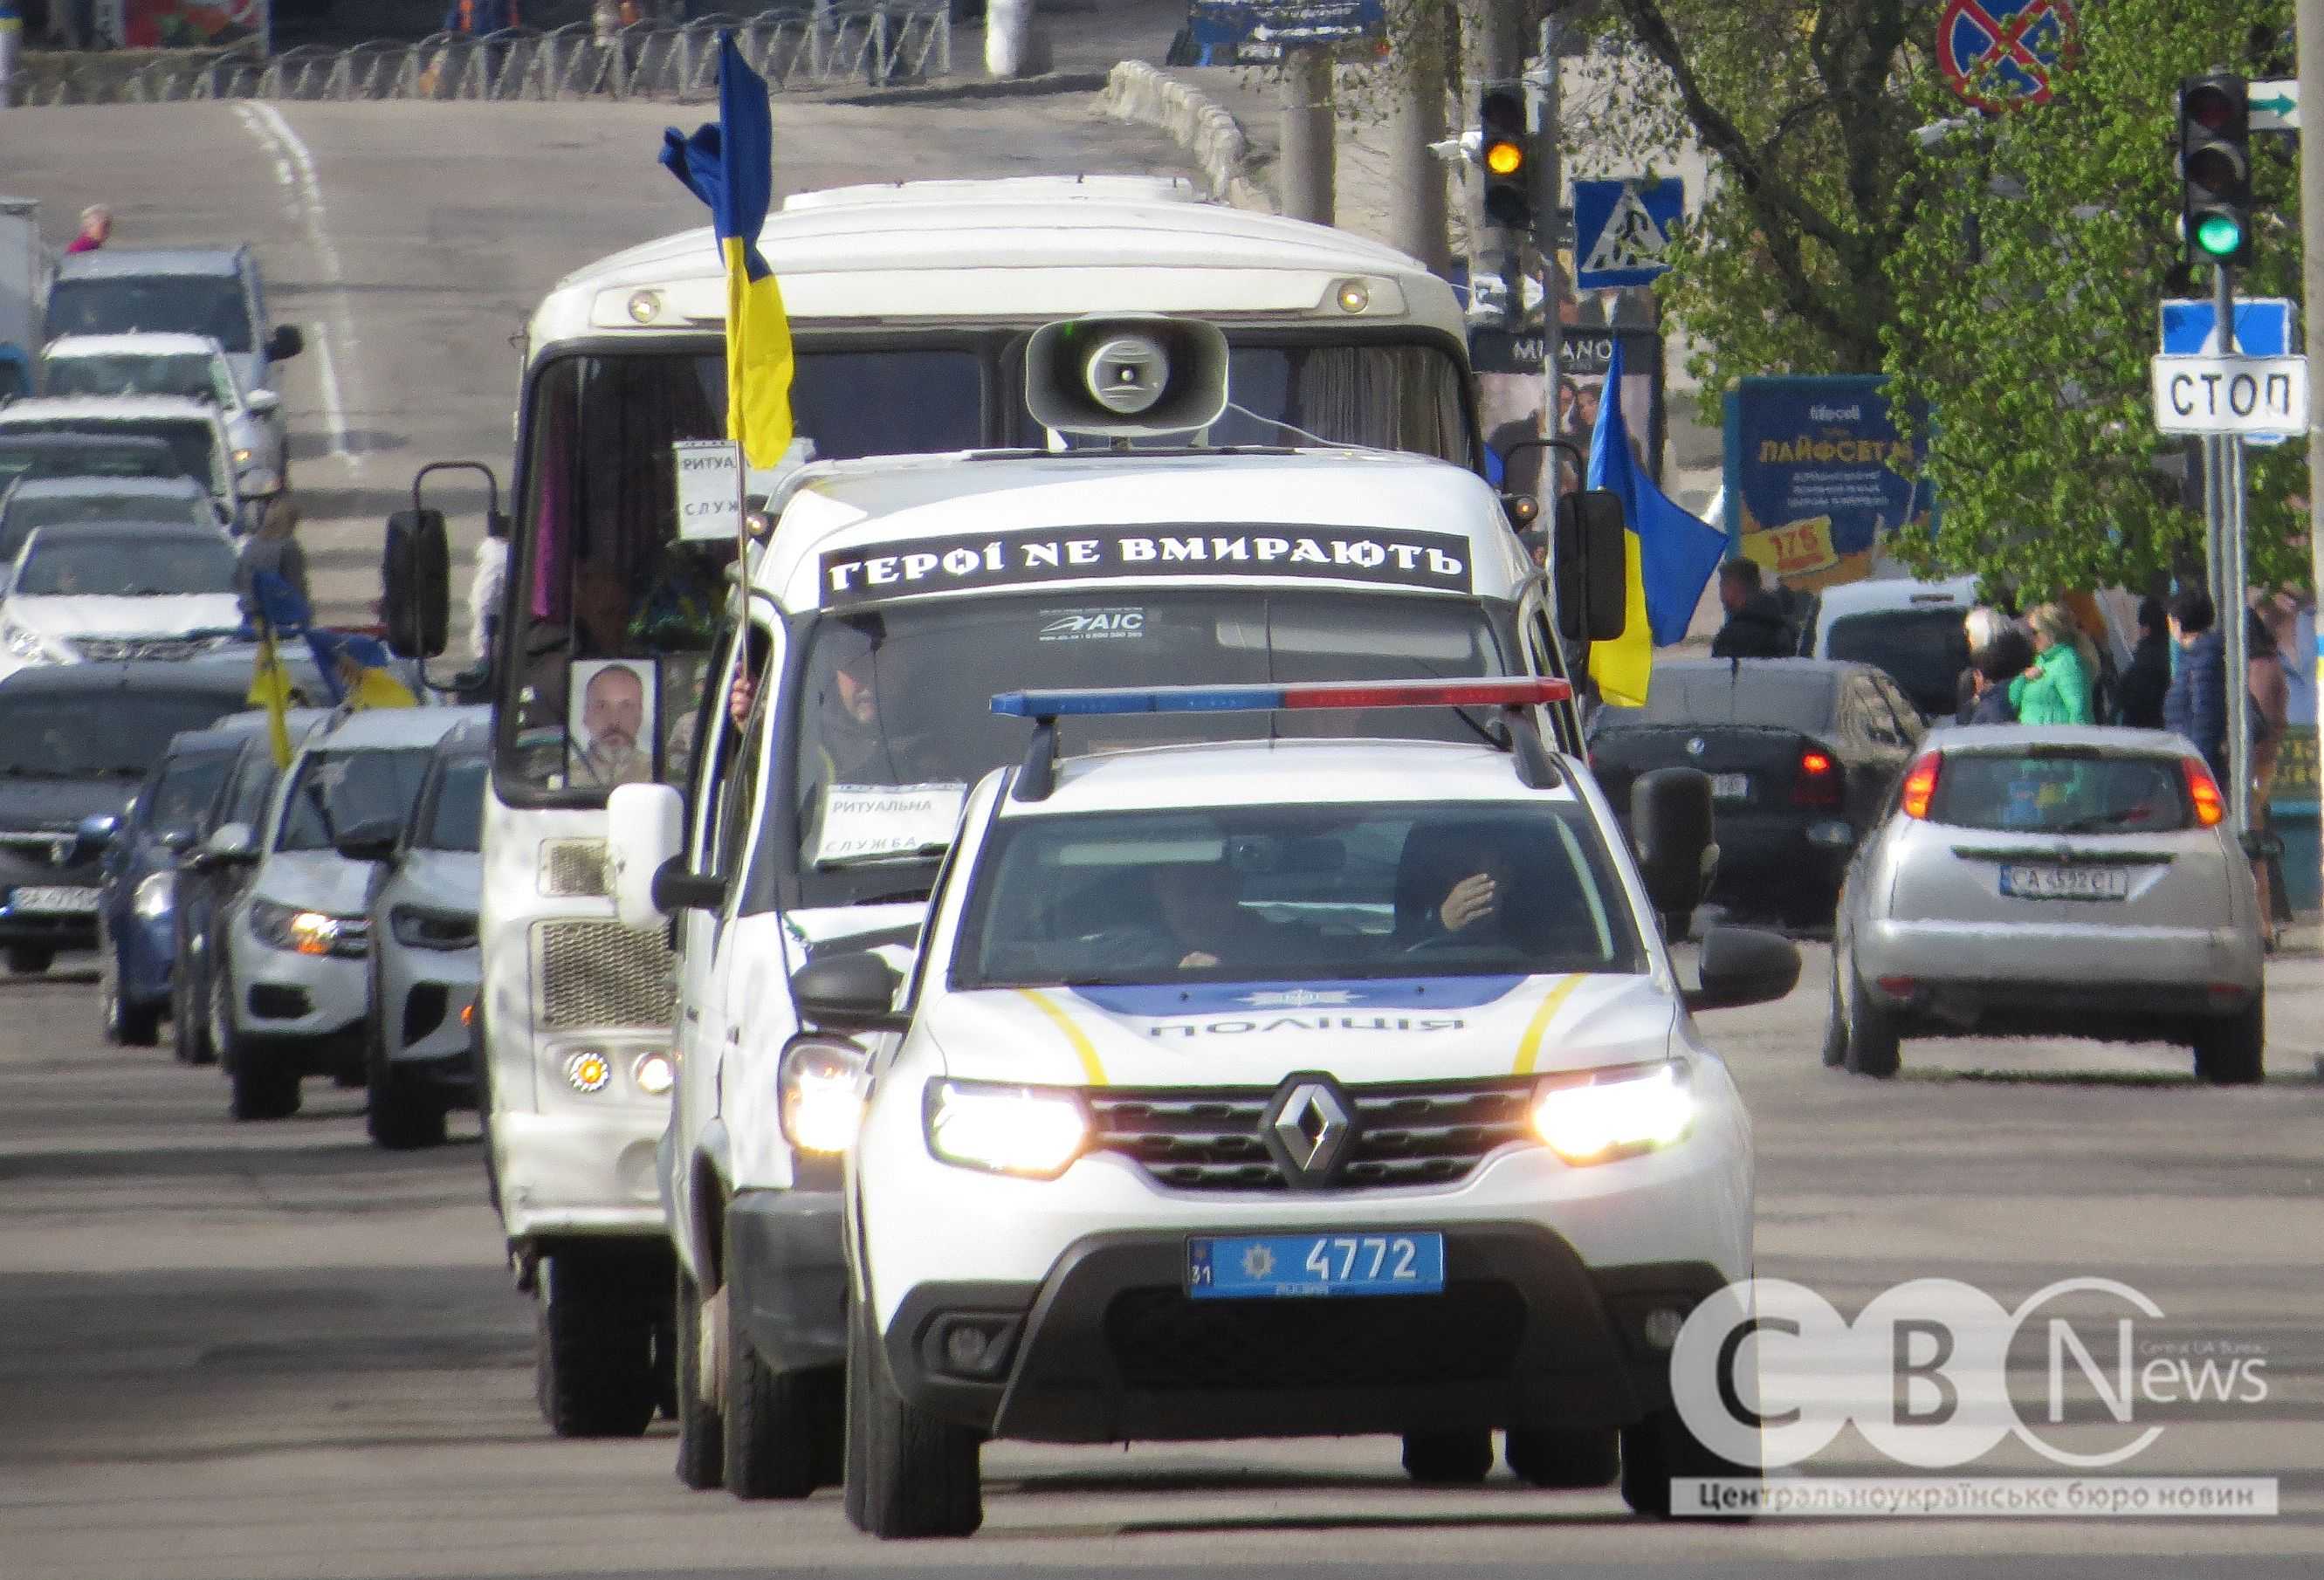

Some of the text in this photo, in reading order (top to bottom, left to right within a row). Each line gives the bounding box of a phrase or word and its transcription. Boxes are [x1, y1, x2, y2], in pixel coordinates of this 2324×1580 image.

[1514, 338, 1613, 361] MIANO
[2171, 373, 2290, 416] СТОП
[829, 540, 1005, 591] ГЕРОЇ
[1117, 536, 1463, 576] ВМИРАЮТЬ
[833, 800, 932, 813] РИТУАЛЬНА
[825, 836, 917, 852] СЛУЖБА
[1151, 1016, 1465, 1037] ПОЛІЦІЯ
[1306, 1238, 1417, 1281] 4772
